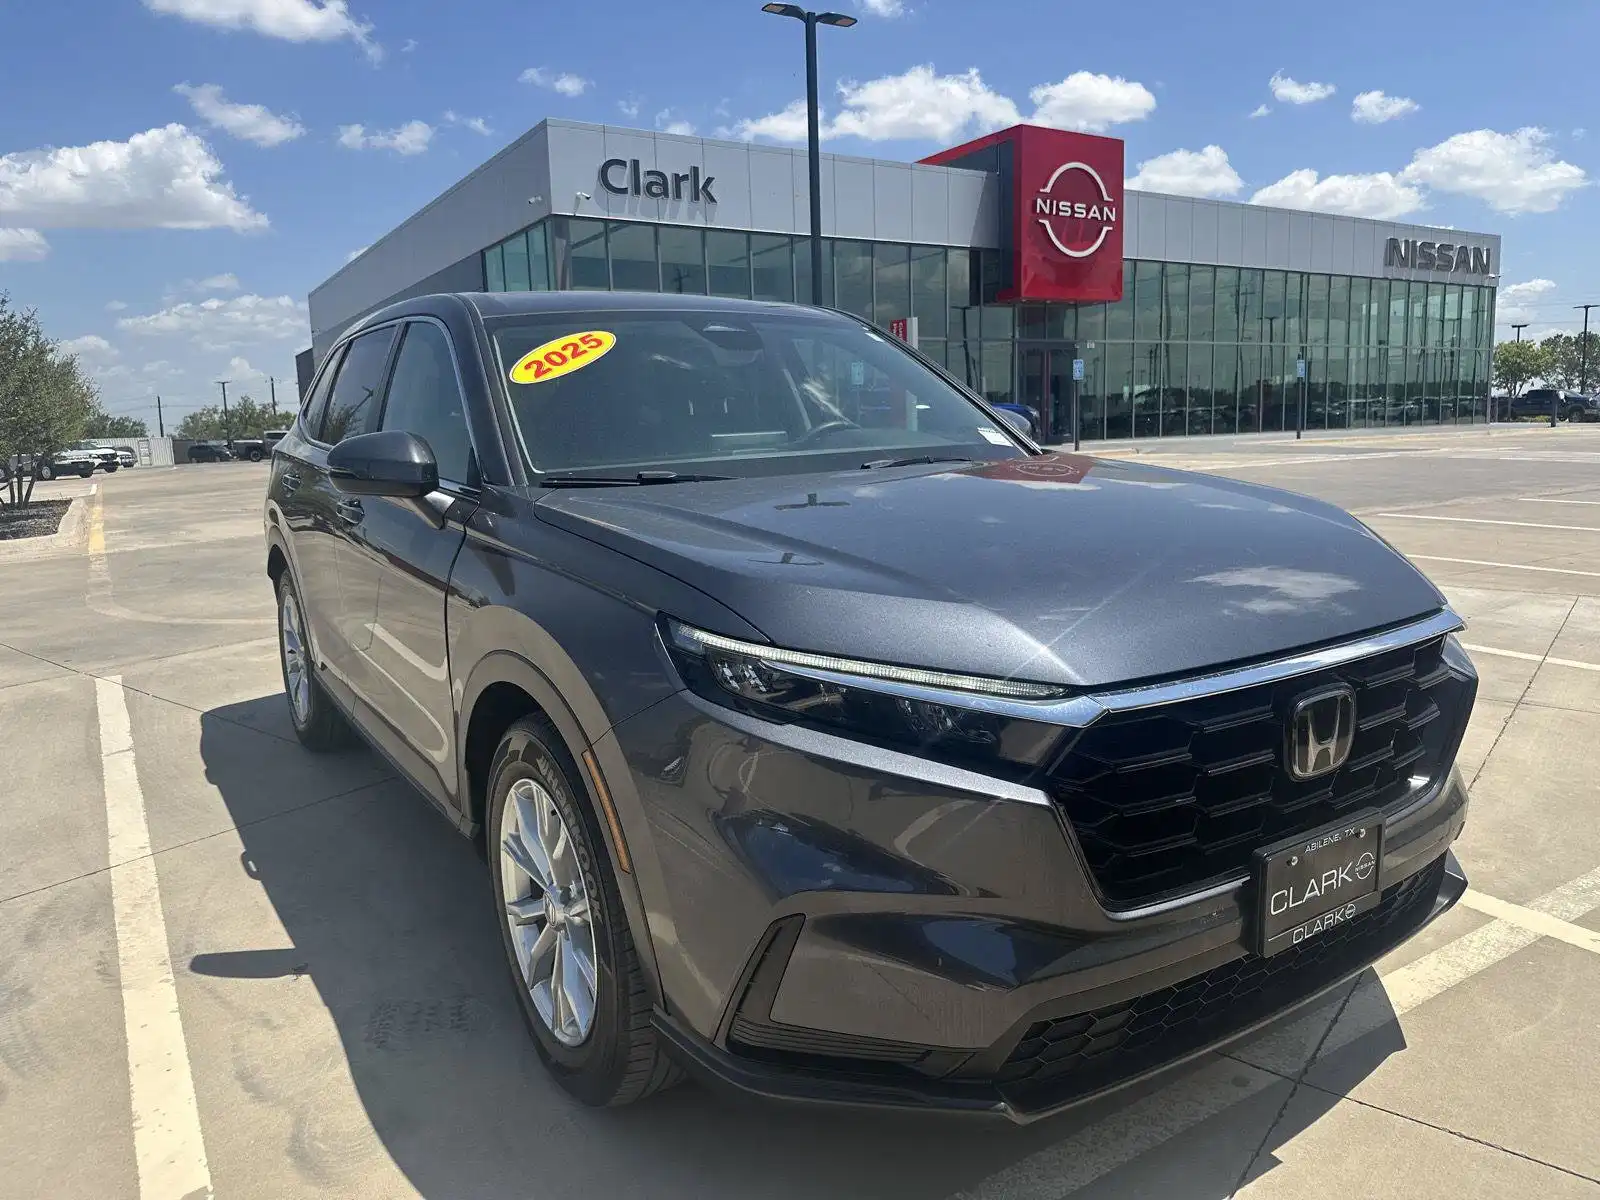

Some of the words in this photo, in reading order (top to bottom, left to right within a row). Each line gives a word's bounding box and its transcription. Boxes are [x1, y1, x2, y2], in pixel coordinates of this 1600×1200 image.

[599, 158, 718, 205] Clark
[1035, 197, 1116, 222] NISSAN
[1385, 237, 1491, 274] NISSAN
[523, 333, 606, 381] 2025
[1344, 827, 1356, 839] TX
[1270, 861, 1353, 916] CLARK
[1292, 908, 1344, 945] CLARK
